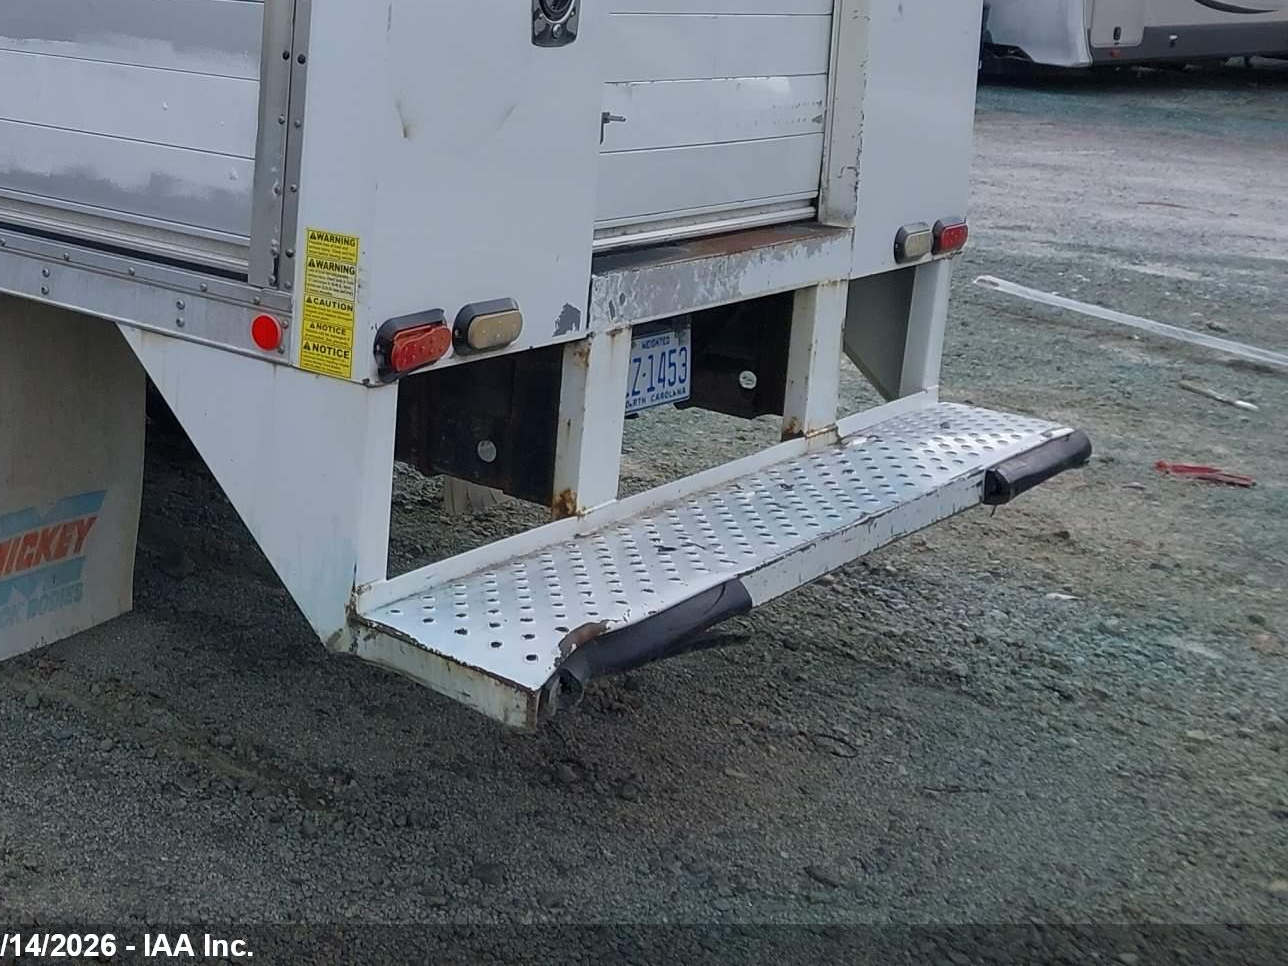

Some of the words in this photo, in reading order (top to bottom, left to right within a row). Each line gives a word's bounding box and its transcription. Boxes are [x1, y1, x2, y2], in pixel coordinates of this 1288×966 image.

[317, 233, 356, 247] WARNING
[316, 259, 356, 275] WARNING
[313, 297, 354, 312] CAUTION
[316, 322, 346, 336] NOTICE
[312, 343, 350, 360] NOTICE
[626, 396, 646, 408] ORTH
